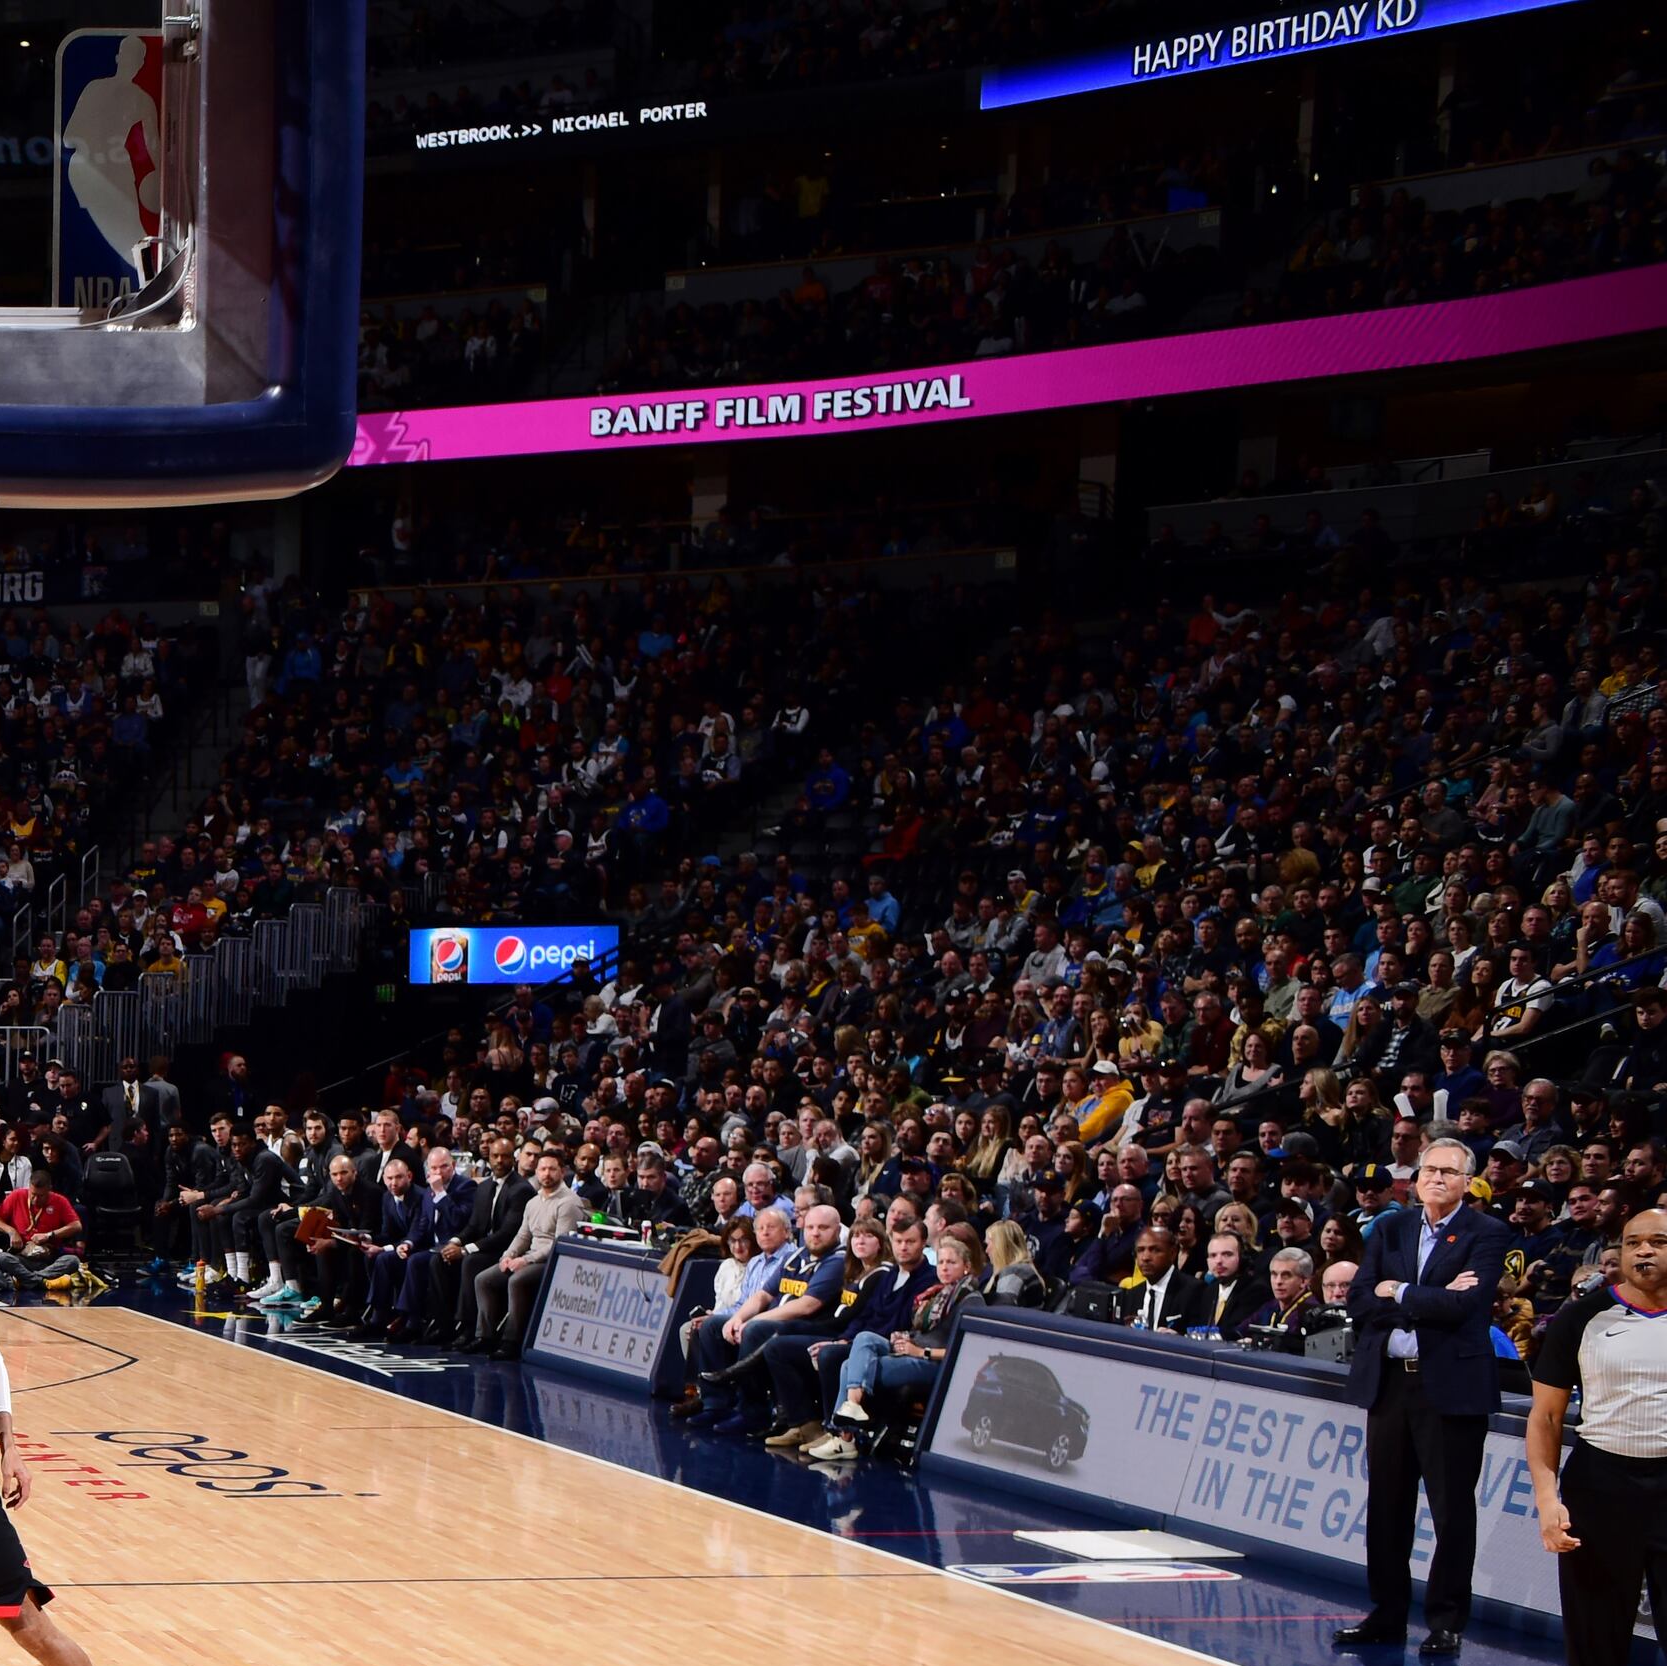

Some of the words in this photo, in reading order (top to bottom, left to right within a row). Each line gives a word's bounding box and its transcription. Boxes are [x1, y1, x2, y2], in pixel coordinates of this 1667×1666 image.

[1132, 30, 1224, 77] HAPPY
[1230, 3, 1370, 59] BIRTHDAY
[1374, 0, 1417, 31] KD
[552, 109, 630, 135] MICHAEL
[639, 101, 708, 124] PORTER
[589, 401, 707, 437] BANFF
[715, 393, 804, 430] FILM
[813, 373, 971, 423] FESTIVAL
[530, 940, 595, 970] pepsi
[550, 1287, 597, 1317] Mountain
[596, 1272, 666, 1331] Honda
[572, 1264, 605, 1293] Rocky
[542, 1316, 655, 1364] DEALERS
[1134, 1384, 1201, 1442] THE
[1202, 1398, 1305, 1466] BEST
[50, 1430, 381, 1499] pepsi
[1192, 1456, 1235, 1511] IN
[1242, 1466, 1316, 1531] THE
